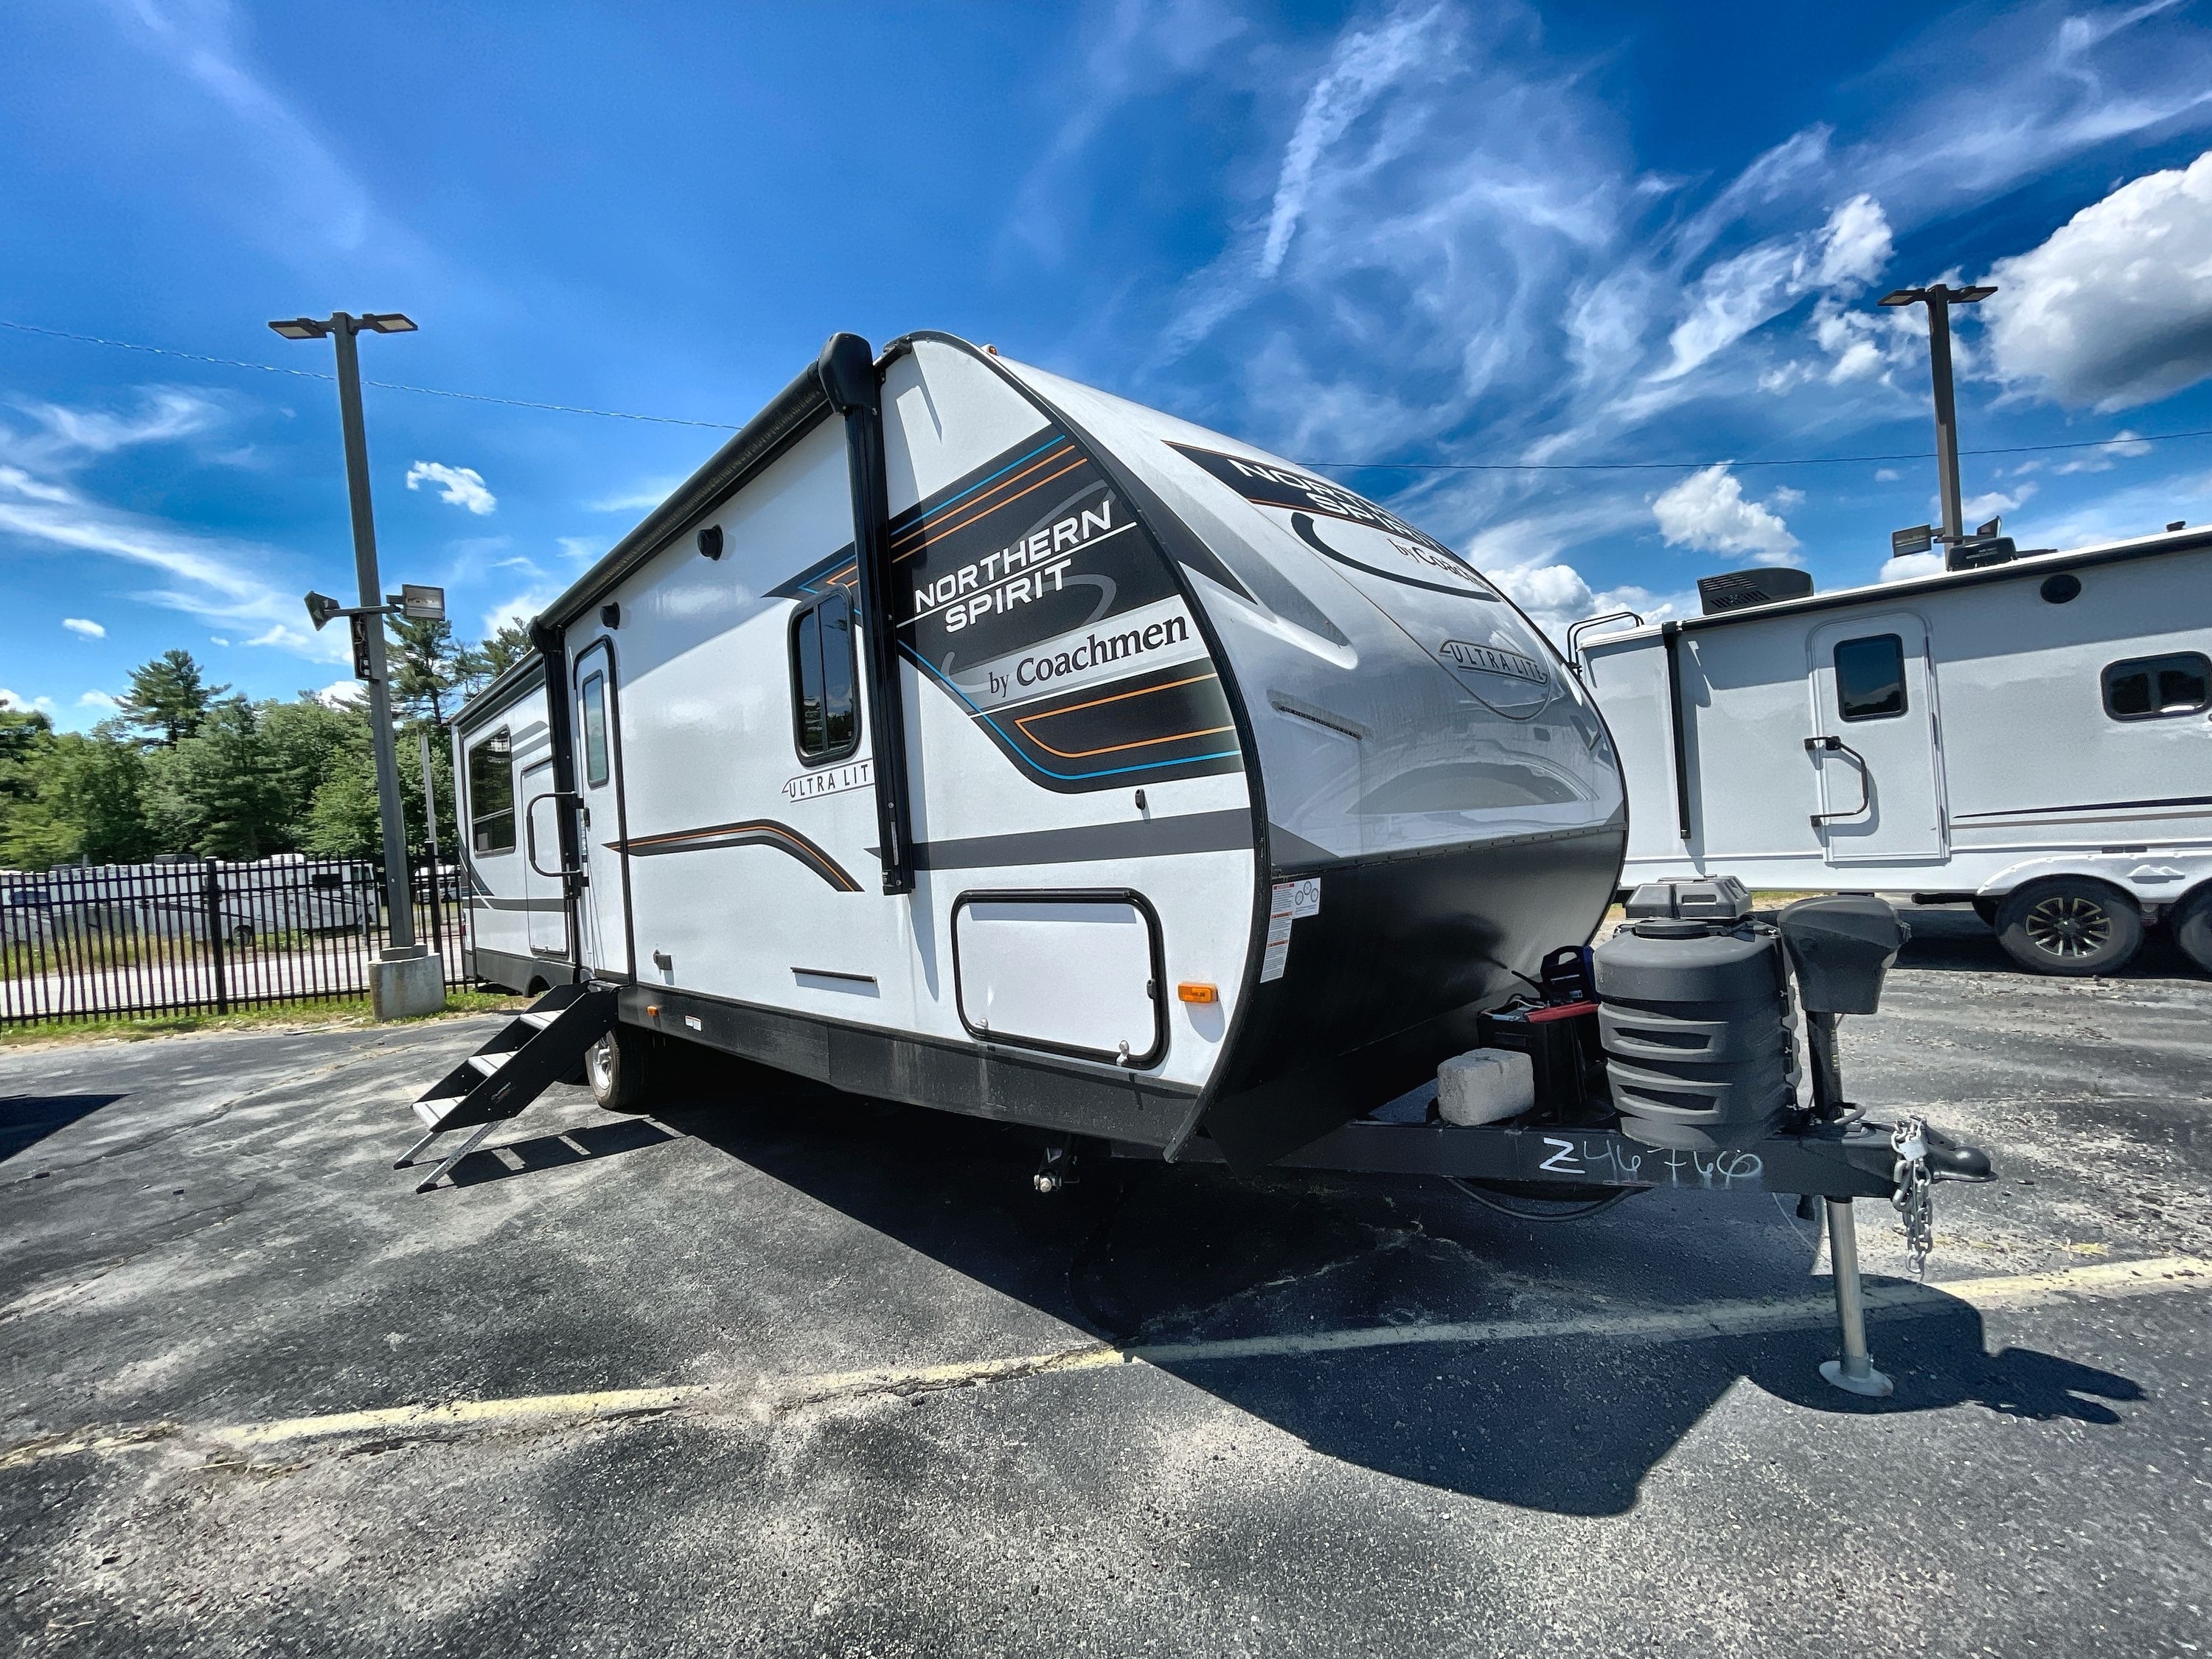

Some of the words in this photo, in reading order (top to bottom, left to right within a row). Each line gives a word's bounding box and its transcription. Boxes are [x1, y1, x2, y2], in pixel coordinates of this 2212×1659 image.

[1227, 459, 1414, 528] NORTH
[914, 500, 1112, 613] NORTHERN
[1386, 538, 1421, 564] by
[1412, 546, 1500, 599] Coach
[946, 559, 1073, 633] SPIRIT
[990, 672, 1010, 698] by
[1016, 615, 1190, 687] Coachmen
[1450, 644, 1511, 672] ULTRA
[1512, 656, 1544, 680] LITE
[789, 773, 835, 798] ULTRA
[844, 764, 869, 786] LIT
